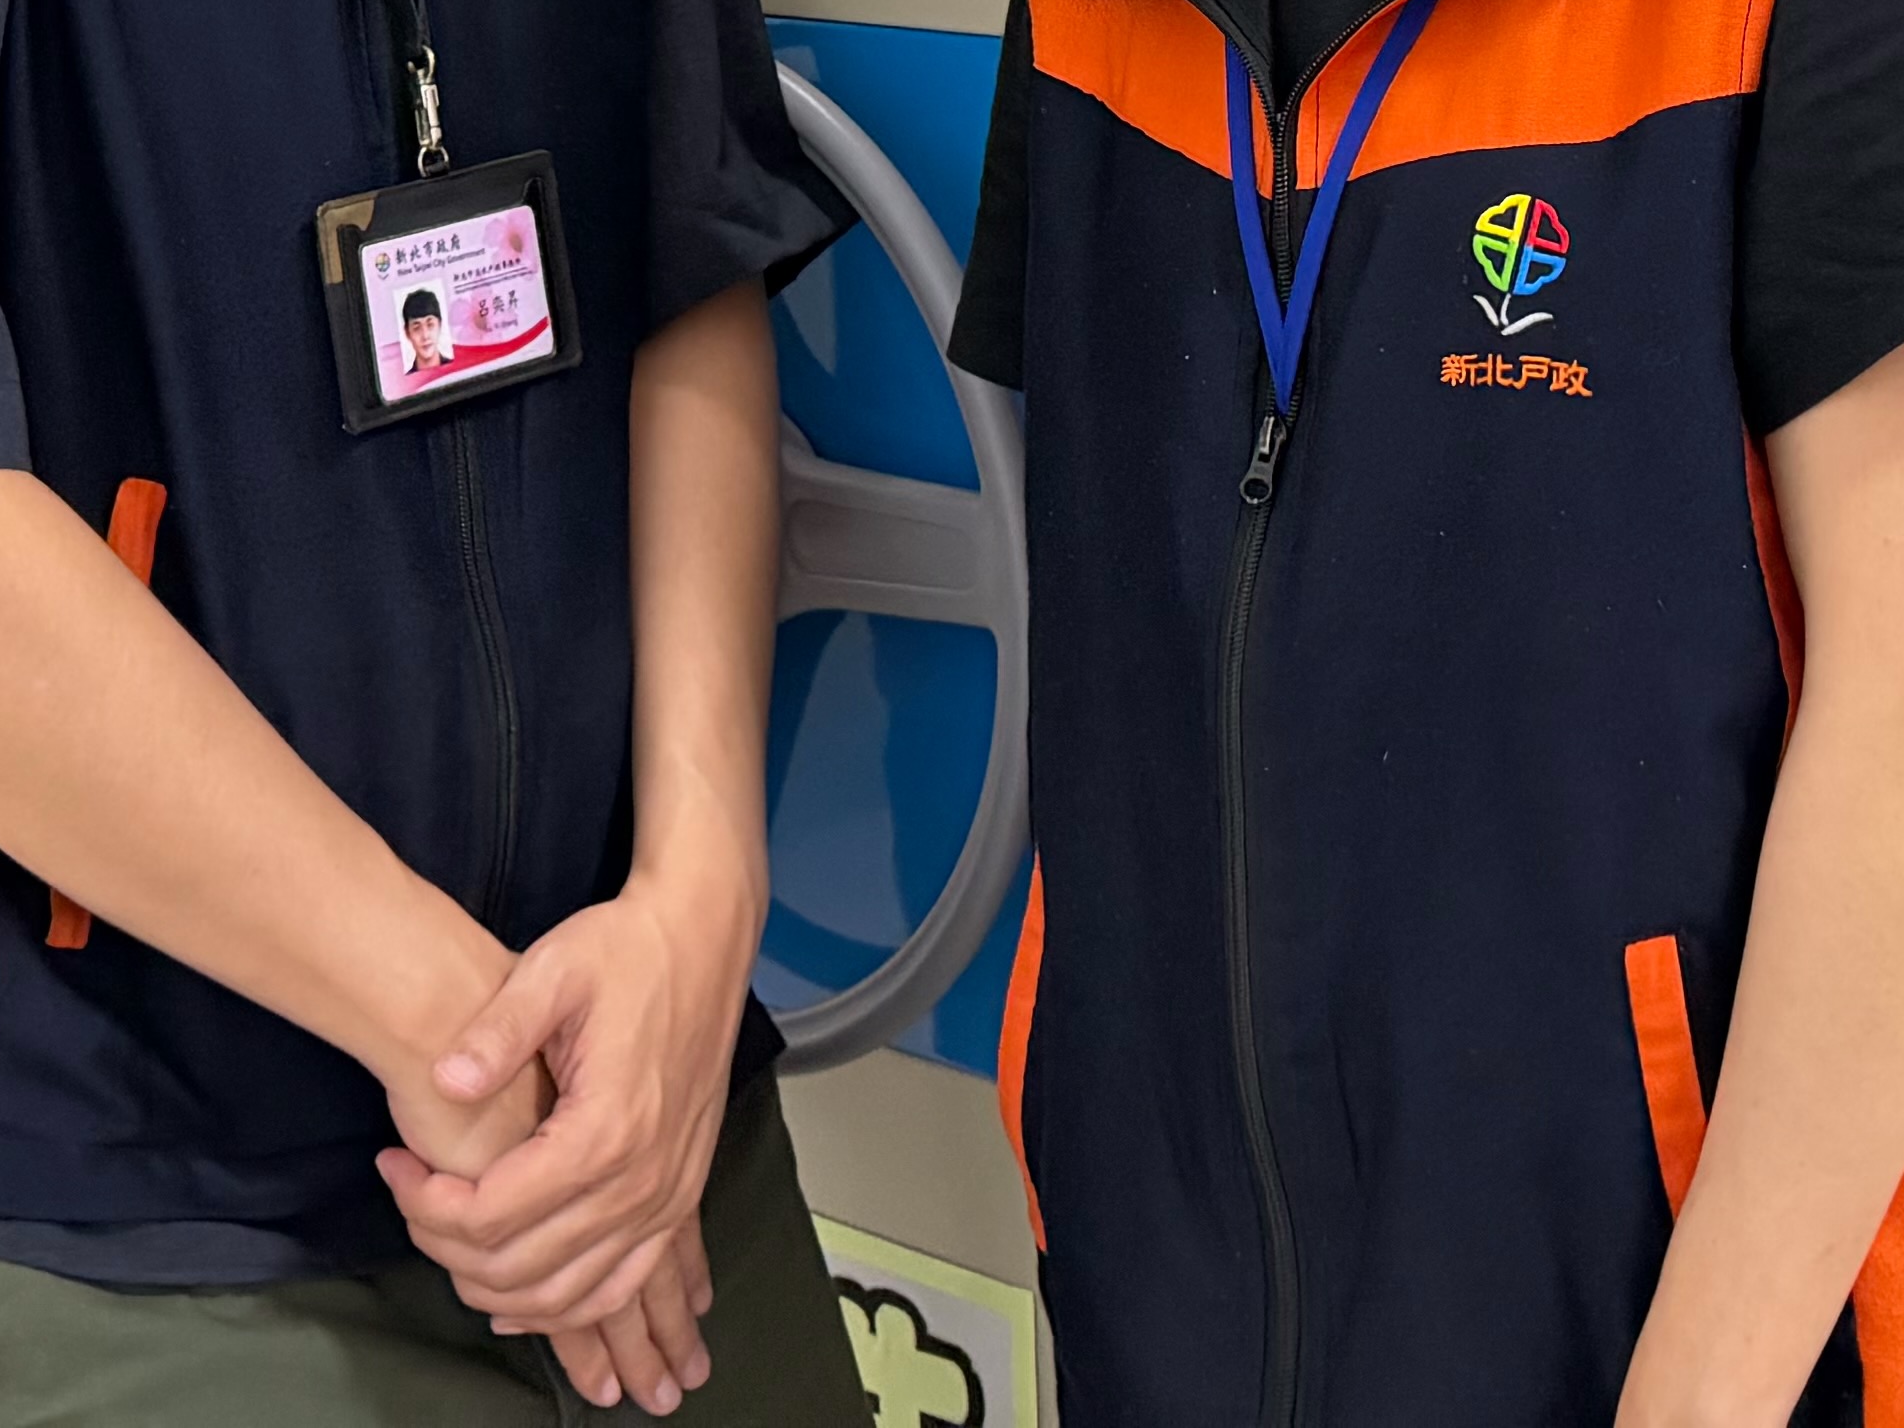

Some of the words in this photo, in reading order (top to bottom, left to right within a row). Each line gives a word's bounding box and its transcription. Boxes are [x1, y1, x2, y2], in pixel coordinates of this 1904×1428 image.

[396, 233, 461, 265] 新北市政府
